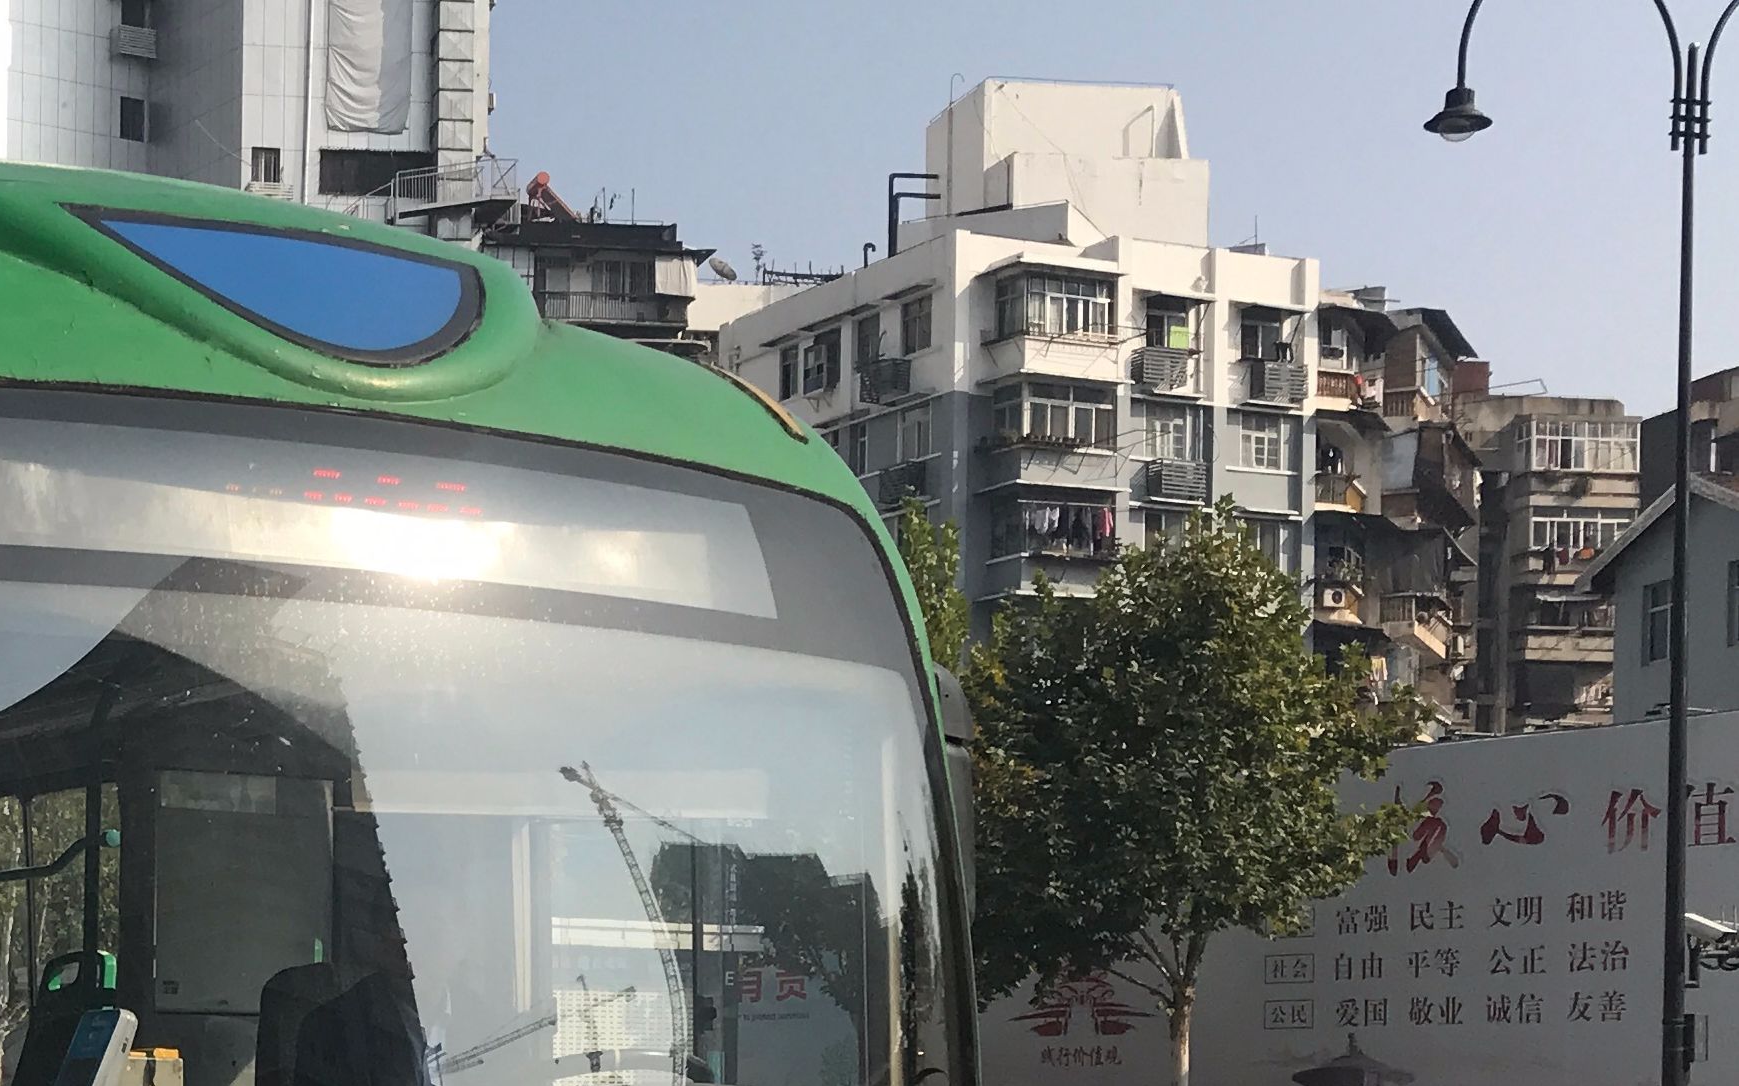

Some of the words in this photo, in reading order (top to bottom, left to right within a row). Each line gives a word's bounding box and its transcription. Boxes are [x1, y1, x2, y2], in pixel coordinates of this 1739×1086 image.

[1336, 904, 1389, 935] 富强
[1410, 900, 1464, 930] 民主
[1489, 896, 1543, 928] 文明
[1566, 890, 1627, 923] 和谐
[1272, 958, 1308, 979] 社会
[1334, 951, 1383, 981] 自由
[1408, 948, 1460, 978] 平等
[1489, 945, 1547, 975] 公正
[1568, 940, 1629, 972] 法治
[1271, 1004, 1307, 1024] 公民
[1336, 998, 1388, 1027] 爱国
[1409, 996, 1463, 1026] 敬业
[1487, 993, 1543, 1024] 诚信
[1566, 990, 1626, 1023] 友善
